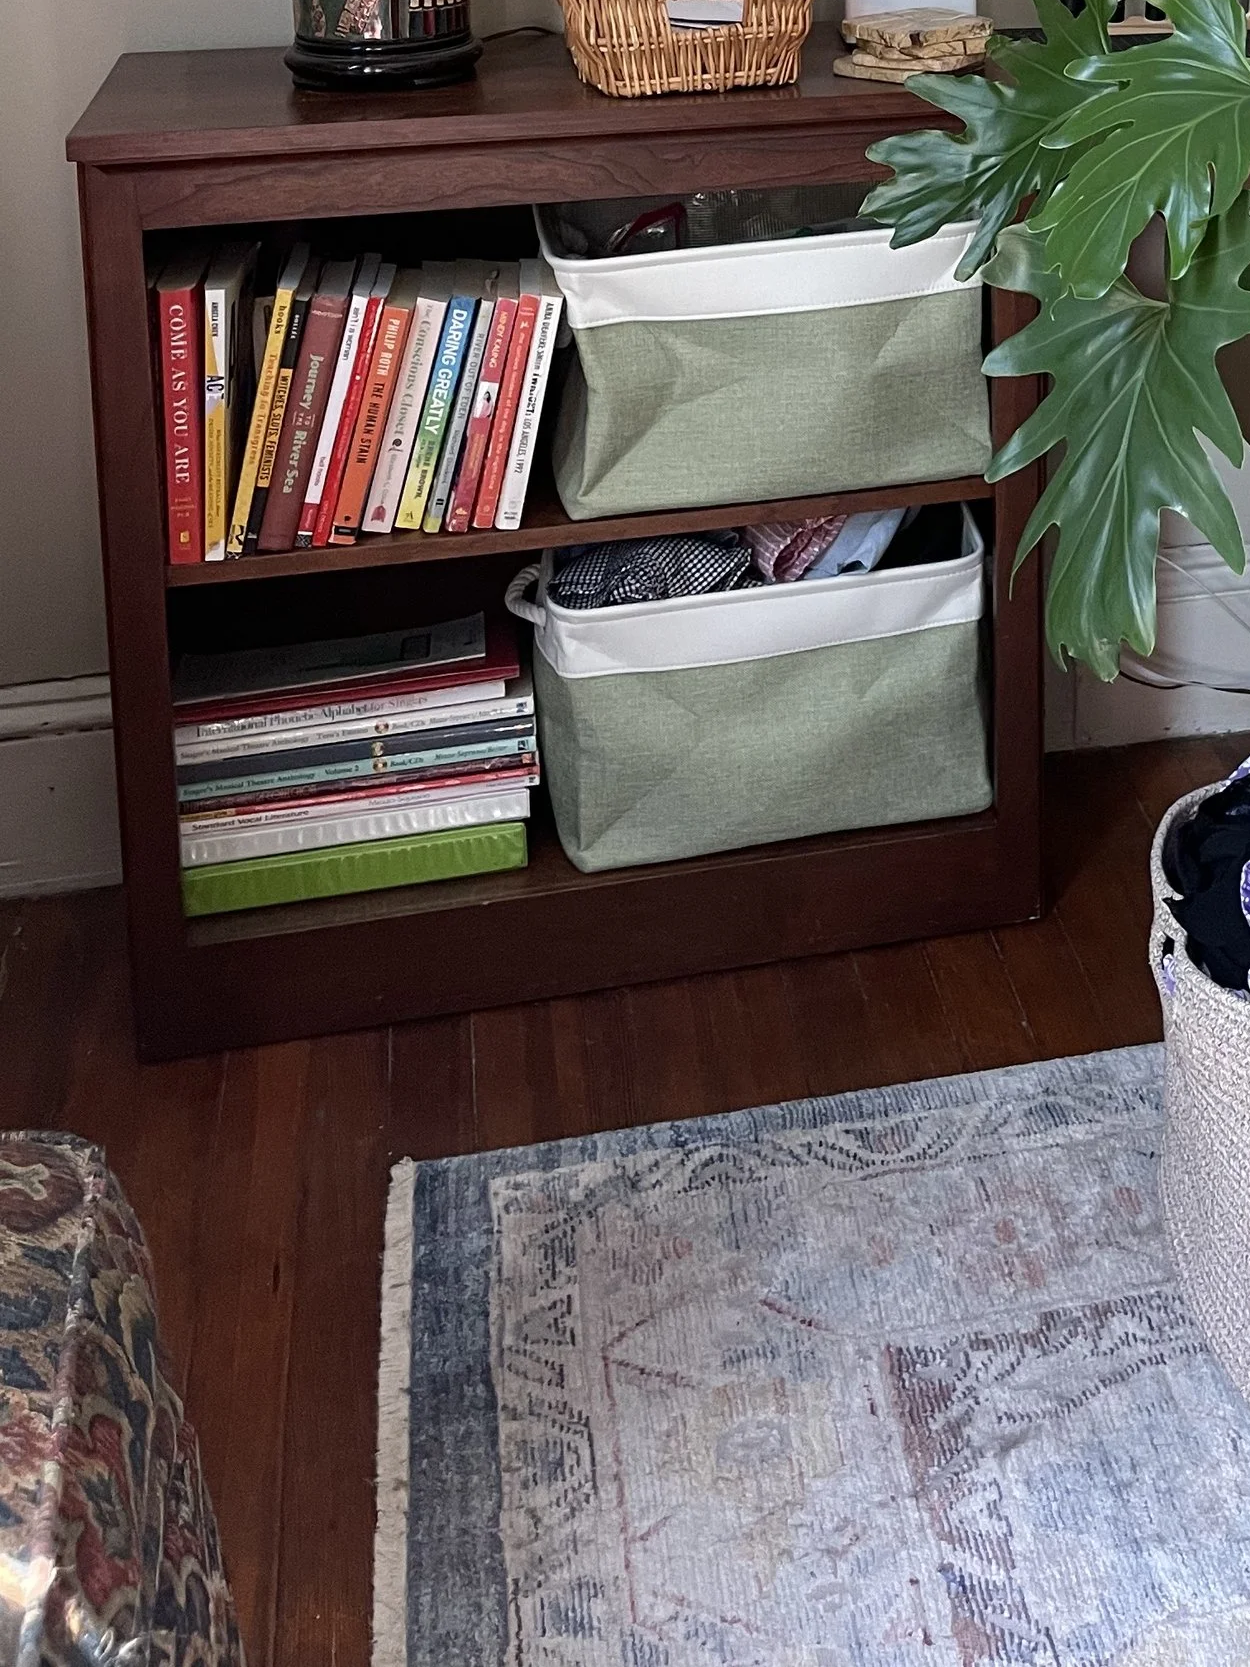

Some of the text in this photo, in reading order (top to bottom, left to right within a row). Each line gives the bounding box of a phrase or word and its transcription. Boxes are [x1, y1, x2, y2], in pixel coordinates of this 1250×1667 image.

[274, 305, 286, 333] hooks
[543, 302, 553, 319] ANNA
[169, 304, 187, 359] COME
[343, 334, 352, 360] woman
[488, 311, 507, 367] MINDY KALING
[405, 320, 430, 389] Conscious
[424, 308, 467, 434] DARING GREATLY
[171, 367, 185, 390] AS
[299, 353, 324, 409] Journey
[356, 318, 400, 463] PHILIP ROTH THE HUMAN STAIN
[457, 333, 484, 418] RIVER OUT OF EDEN
[173, 398, 187, 435] YOU
[393, 393, 412, 434] Closet
[522, 418, 531, 429] LOS
[174, 445, 189, 483] ARE
[282, 430, 307, 492] River Sea
[514, 459, 524, 473] 1992
[321, 703, 368, 720] Alphabet
[215, 781, 243, 791] Musical
[237, 816, 261, 824] Vocal
